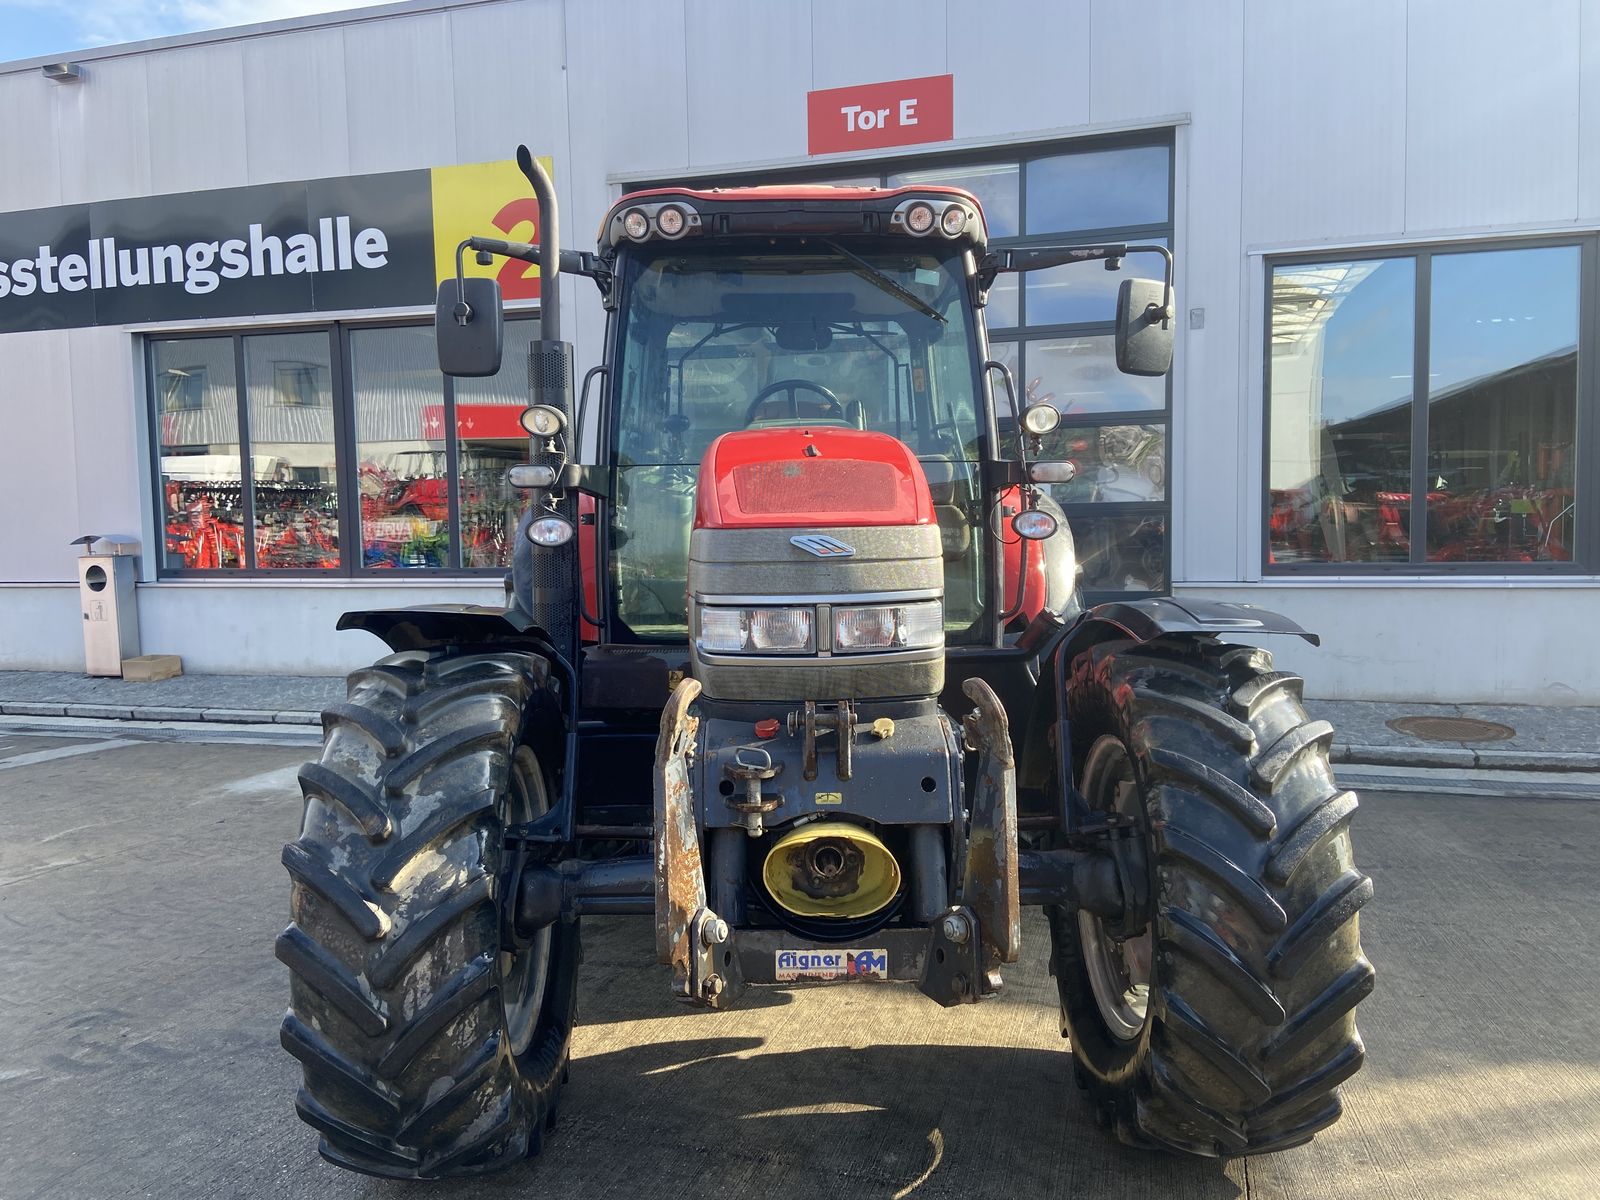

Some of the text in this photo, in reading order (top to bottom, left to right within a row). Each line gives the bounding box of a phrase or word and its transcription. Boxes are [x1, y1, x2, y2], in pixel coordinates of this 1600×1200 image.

[841, 98, 918, 132] Tor E
[491, 197, 541, 301] 2
[778, 951, 841, 970] Aigner
